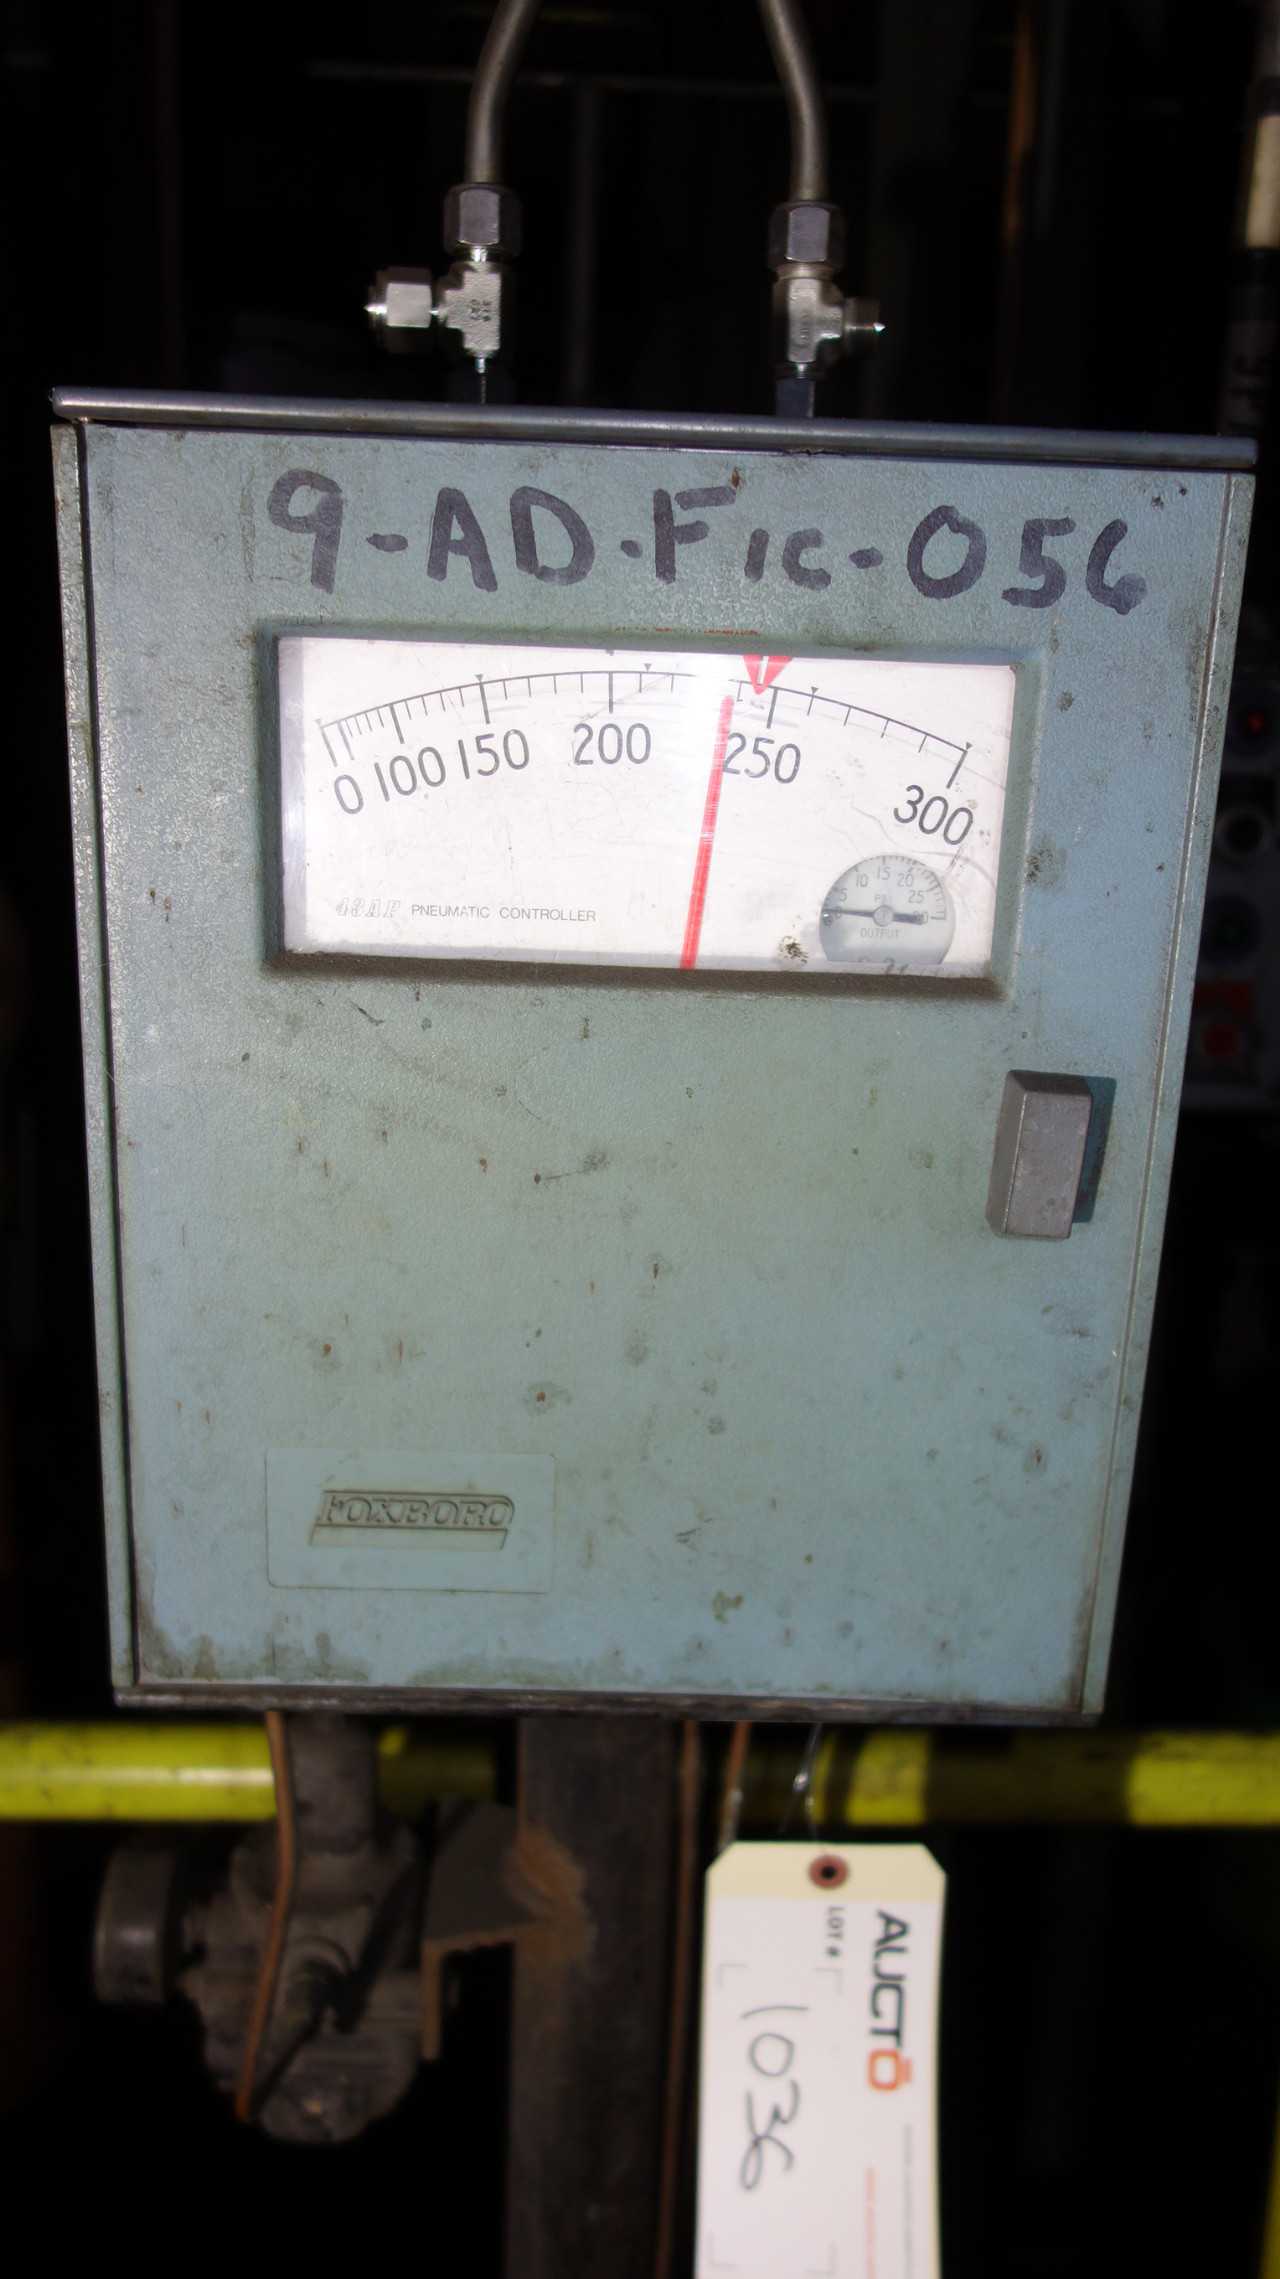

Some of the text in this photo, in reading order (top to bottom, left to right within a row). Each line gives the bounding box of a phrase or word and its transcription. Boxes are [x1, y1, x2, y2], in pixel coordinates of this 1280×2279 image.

[458, 729, 530, 779] 150
[573, 723, 651, 765] 200
[722, 732, 801, 784] 250
[374, 747, 446, 802] 100
[333, 774, 364, 815] 0
[893, 785, 973, 845] 300
[856, 873, 869, 888] 10
[876, 866, 891, 881] 15
[897, 873, 914, 888] 20
[838, 888, 848, 902] 5
[908, 890, 925, 905] 25
[411, 904, 490, 919] PNEUMATIC
[499, 906, 596, 922] CONTROLLER
[860, 927, 900, 940] OUTPUT
[326, 1496, 513, 1526] FOXBORO
[825, 1905, 844, 1940] LOT
[740, 2004, 810, 2192] 1036
